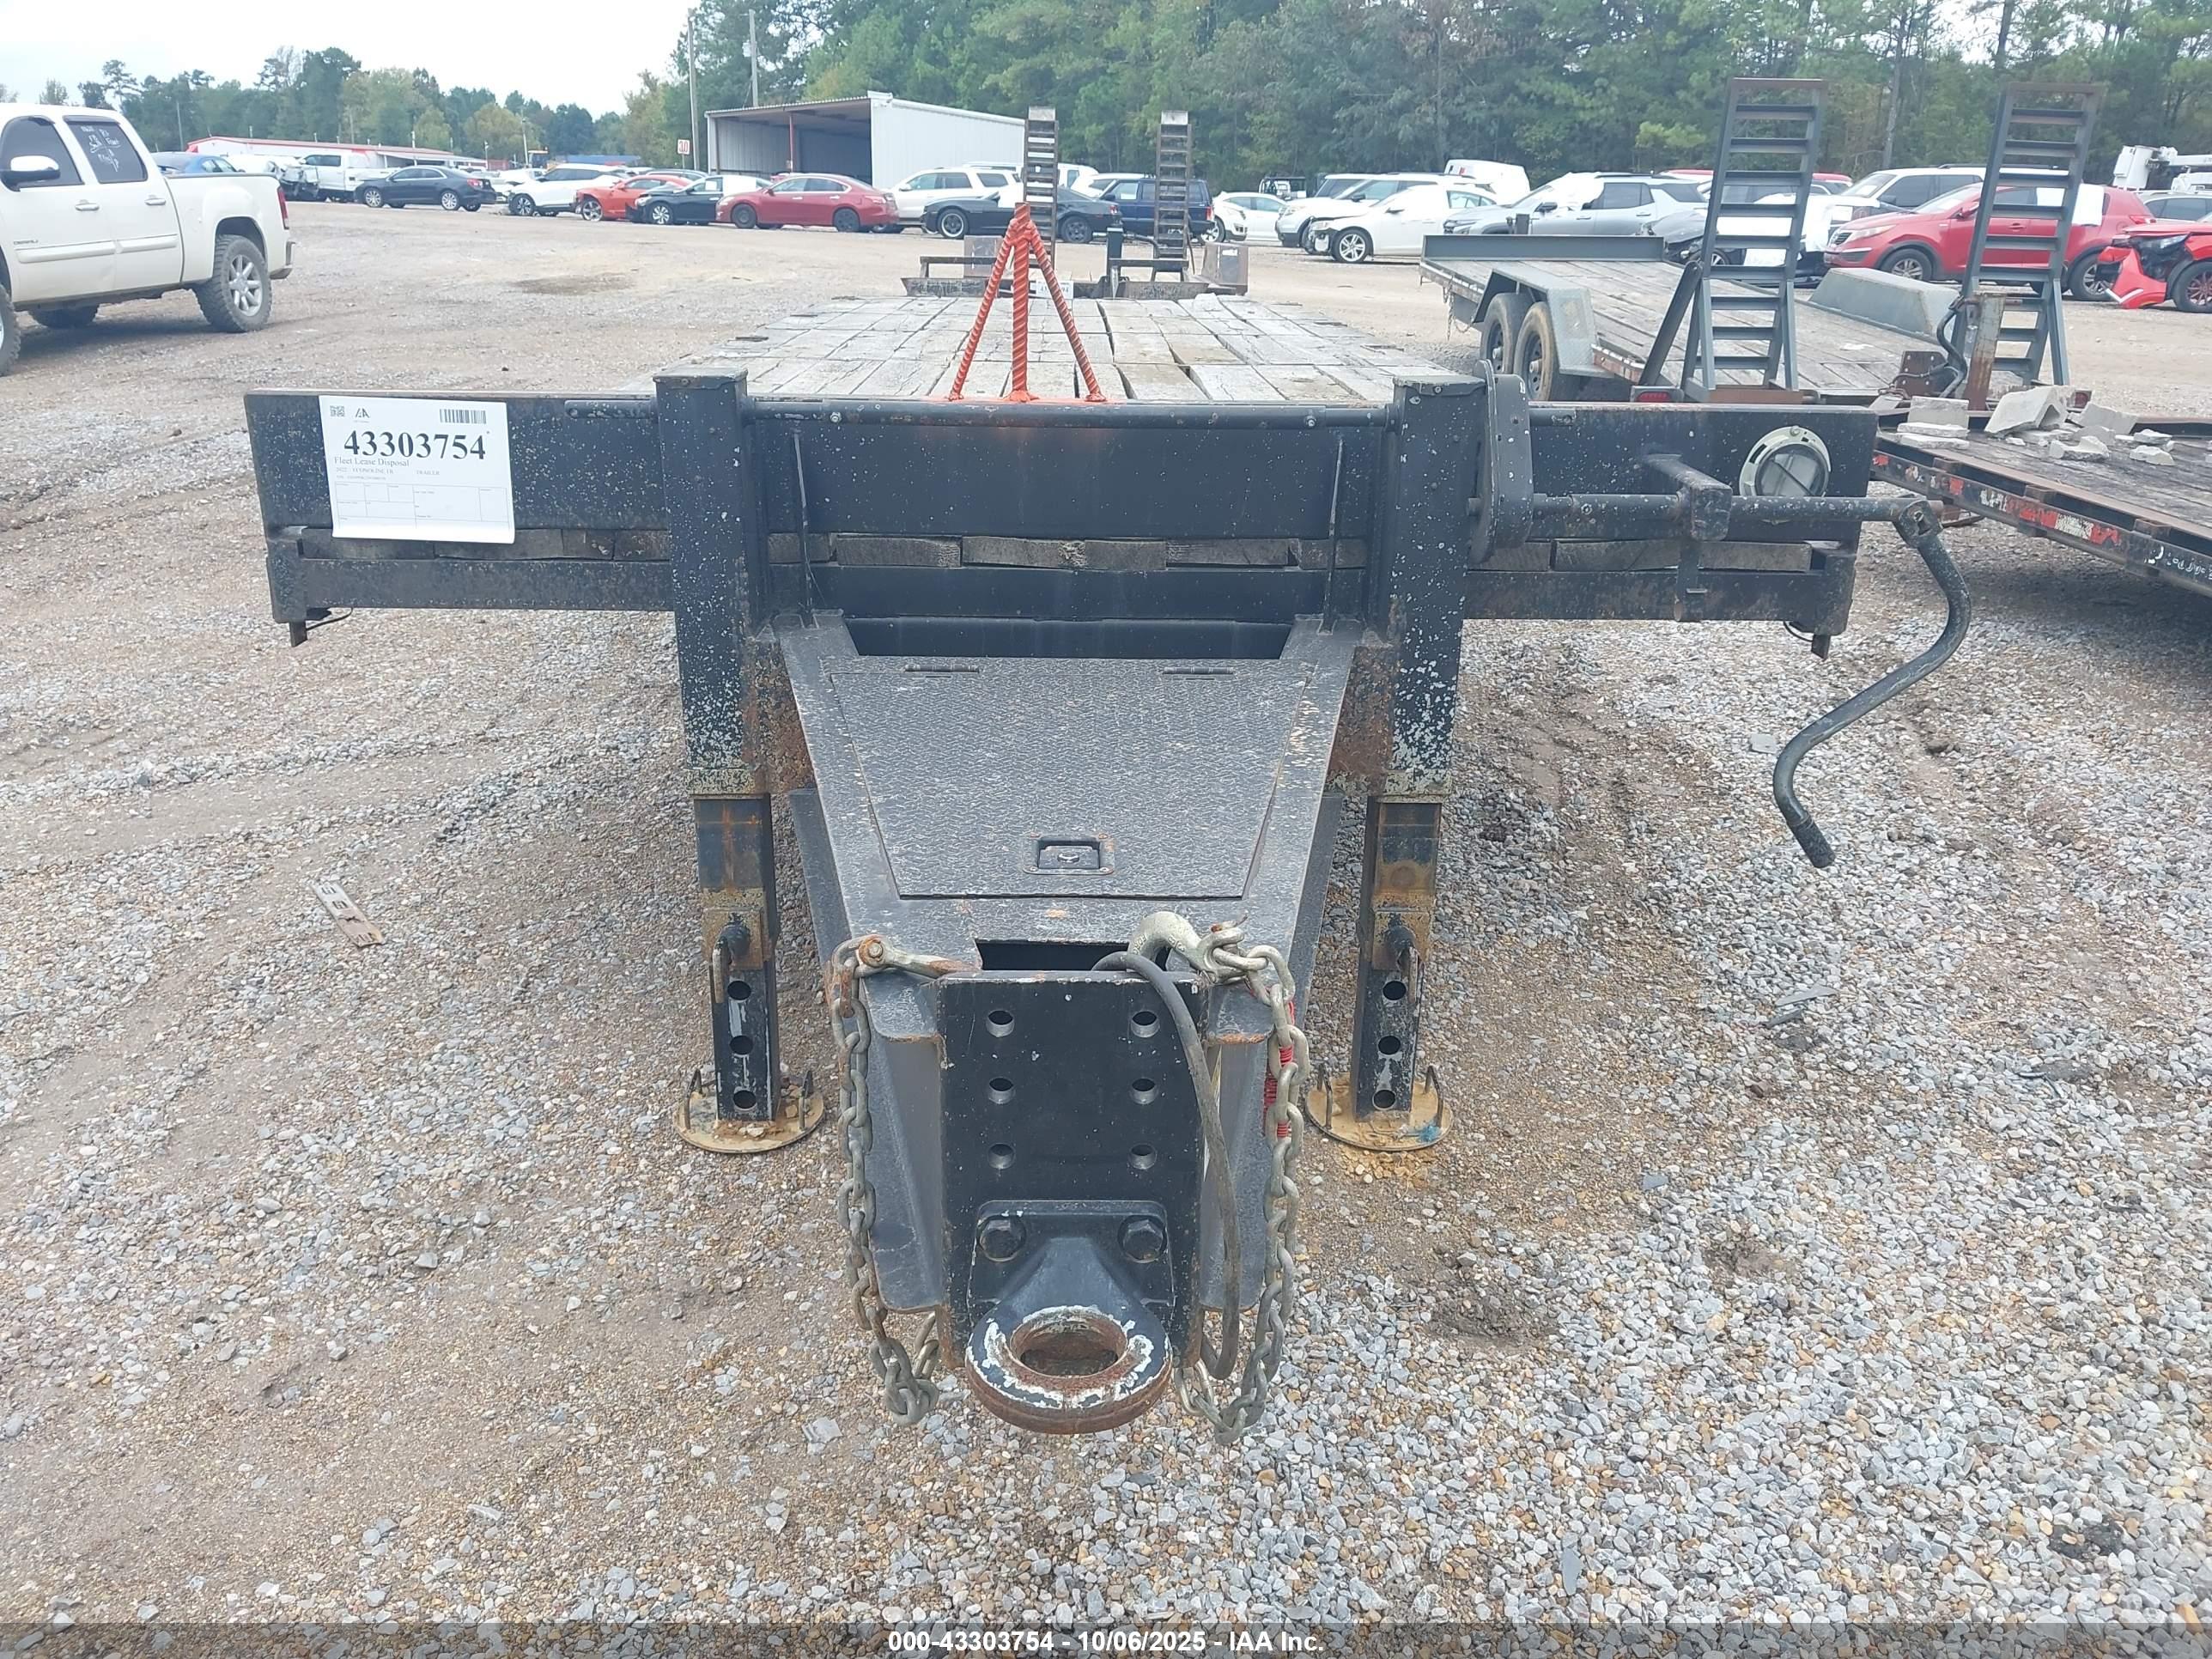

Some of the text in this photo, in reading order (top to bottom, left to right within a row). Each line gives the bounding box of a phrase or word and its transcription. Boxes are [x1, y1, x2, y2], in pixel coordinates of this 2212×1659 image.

[343, 430, 486, 460] 43303754
[334, 456, 353, 465] Fleet
[378, 459, 410, 468] Disposal
